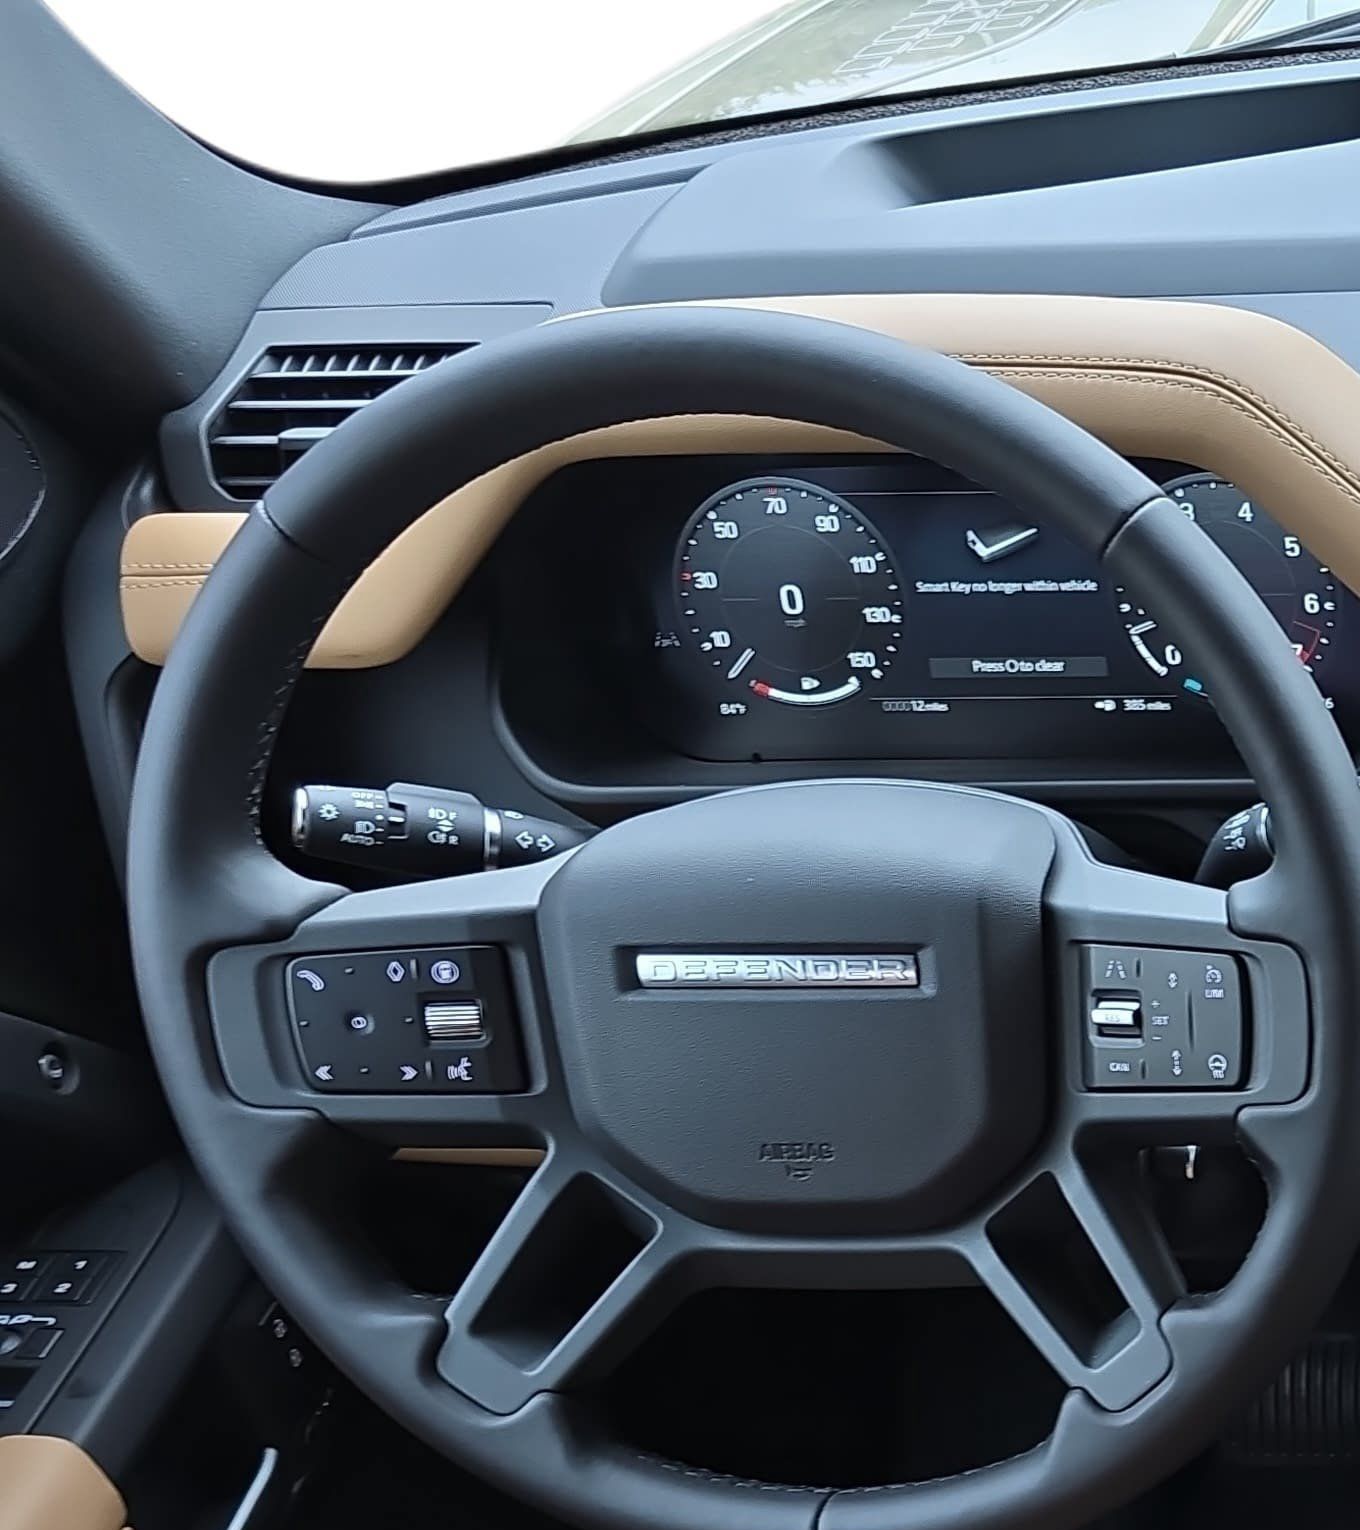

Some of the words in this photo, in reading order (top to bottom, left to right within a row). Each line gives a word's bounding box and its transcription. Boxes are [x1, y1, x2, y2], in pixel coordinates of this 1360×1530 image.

[763, 497, 787, 514] 70
[1237, 501, 1254, 522] 4
[713, 521, 738, 539] 50
[815, 514, 839, 533] 90
[1283, 536, 1301, 558] 5
[849, 555, 877, 573] 110
[692, 571, 718, 589] 30
[915, 581, 950, 593] Smart
[950, 582, 971, 595] Key
[988, 581, 1023, 595] longer
[1023, 581, 1059, 592] within
[1059, 580, 1098, 592] vehicle
[779, 584, 805, 616] 0
[1303, 592, 1321, 615] 6
[862, 607, 891, 623] 130
[710, 631, 731, 648] 10
[847, 652, 876, 668] 150
[972, 661, 1005, 673] Press
[1035, 659, 1065, 672] clear
[651, 960, 909, 982] DEFENDER
[759, 1143, 835, 1161] AIRBAG
